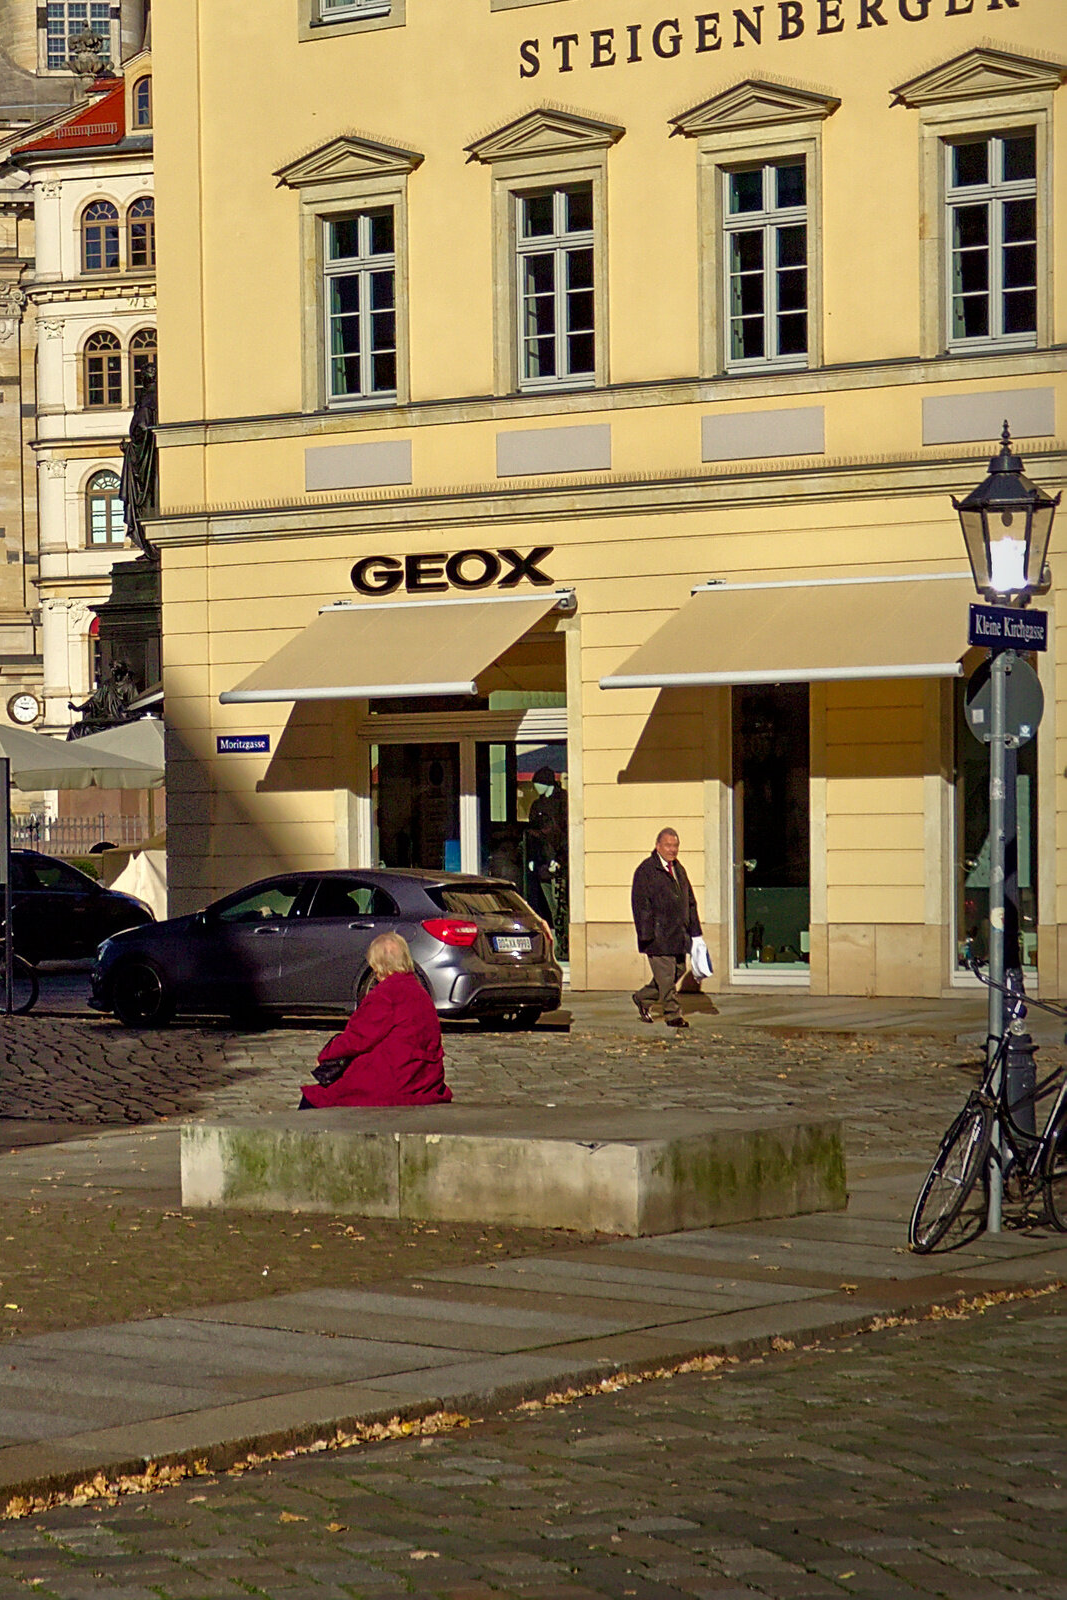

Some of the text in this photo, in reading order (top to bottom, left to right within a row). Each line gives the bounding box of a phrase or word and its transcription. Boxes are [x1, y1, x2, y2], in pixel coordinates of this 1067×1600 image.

[350, 546, 555, 596] GEOX
[975, 613, 1045, 642] Kleine Kirchgasse
[220, 739, 266, 750] Moritzgasse
